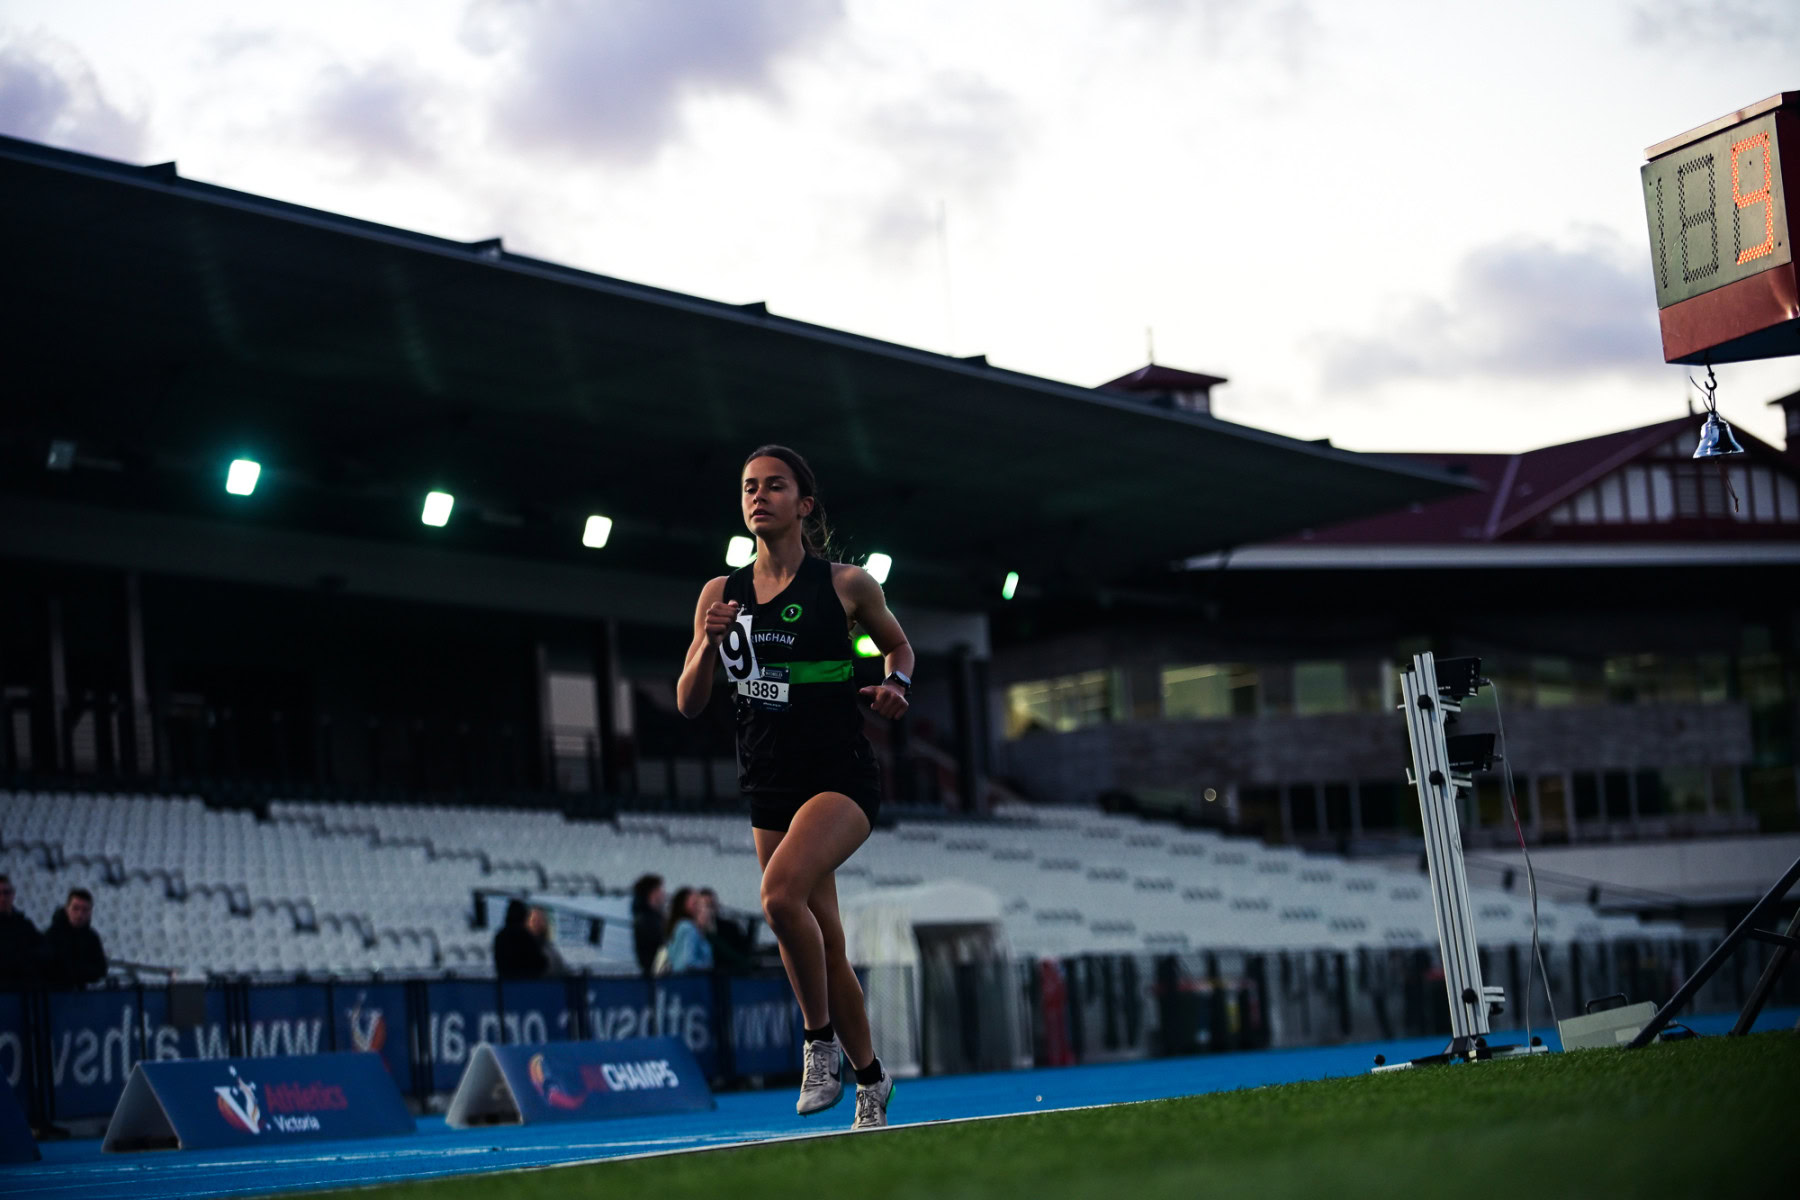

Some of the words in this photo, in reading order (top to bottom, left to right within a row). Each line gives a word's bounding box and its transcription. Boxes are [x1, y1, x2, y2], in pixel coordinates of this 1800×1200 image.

[722, 621, 752, 680] 9
[746, 680, 779, 699] 1389
[273, 1113, 320, 1132] Victoria
